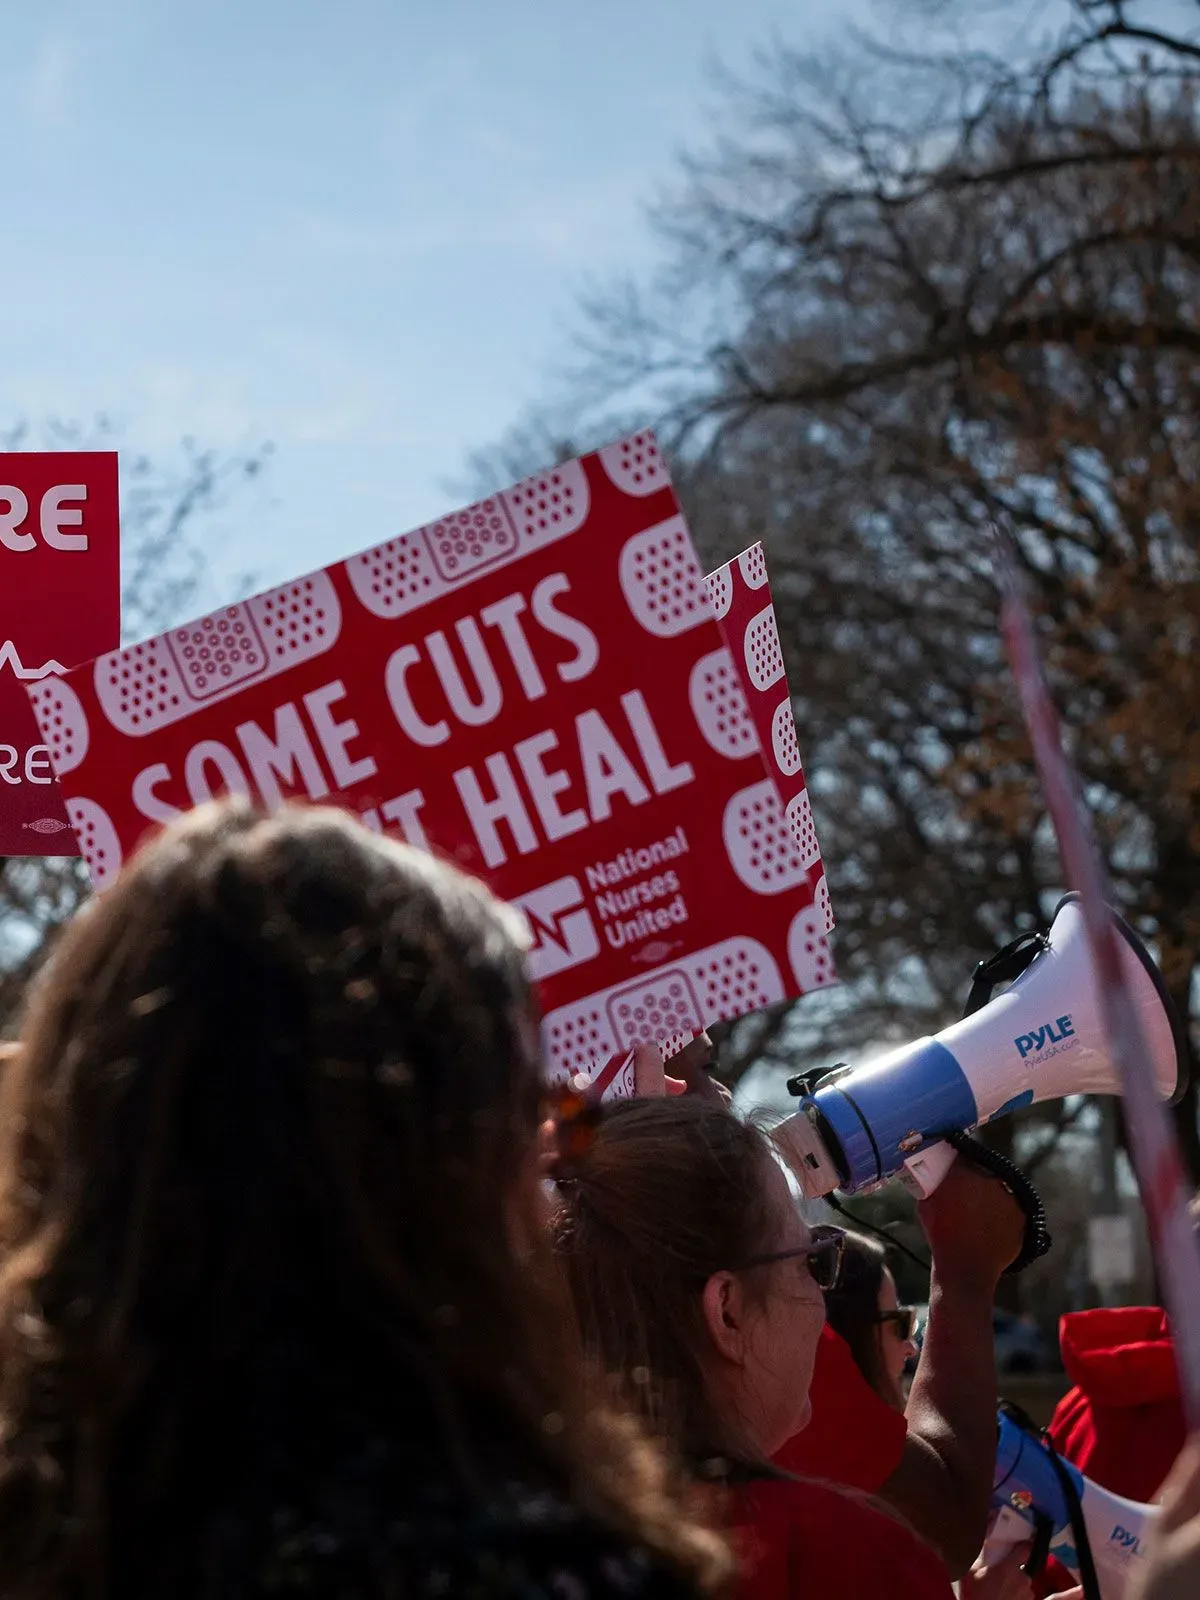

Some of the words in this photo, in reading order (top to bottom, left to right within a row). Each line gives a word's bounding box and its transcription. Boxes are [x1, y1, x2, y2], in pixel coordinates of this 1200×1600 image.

[131, 679, 379, 826] SOME
[384, 571, 600, 748] CUTS
[452, 688, 696, 870] HEAL
[584, 825, 690, 892] National
[595, 869, 681, 921] Nurses
[603, 893, 689, 950] United
[1014, 1014, 1075, 1058] PYLE
